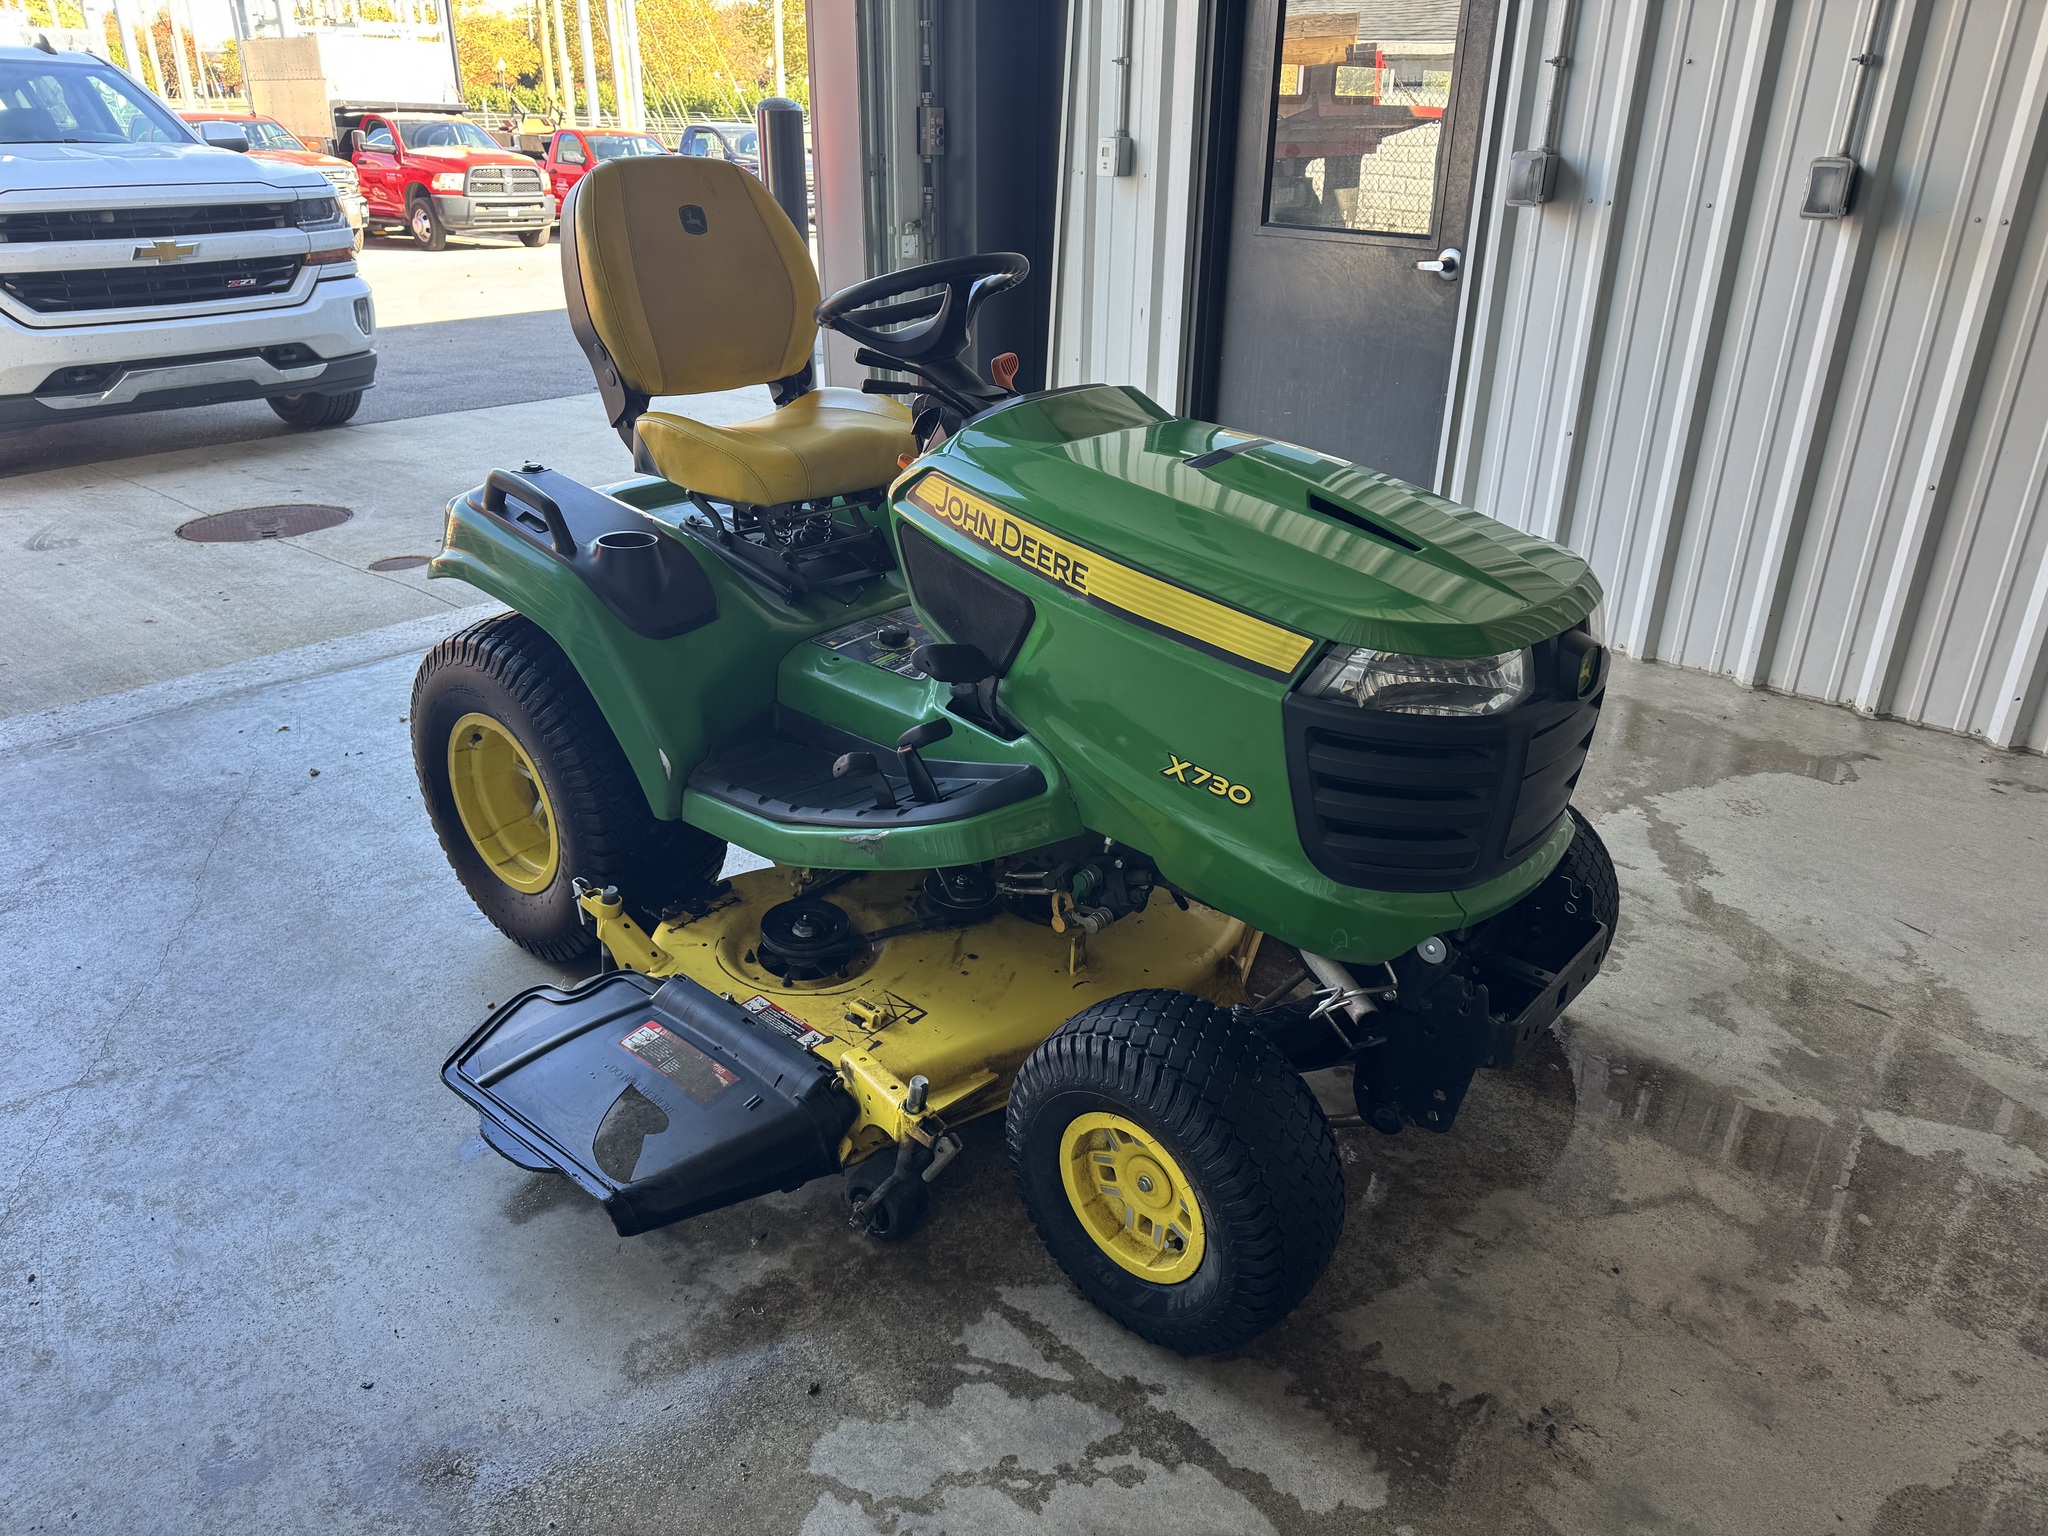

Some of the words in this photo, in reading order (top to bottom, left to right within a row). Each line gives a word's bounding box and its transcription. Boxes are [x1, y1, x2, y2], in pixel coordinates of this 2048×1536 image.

[935, 486, 997, 542] JOHN
[1001, 518, 1089, 591] DEERE
[1161, 753, 1252, 805] X730
[608, 1064, 624, 1077] DO
[621, 1073, 643, 1088] NOT
